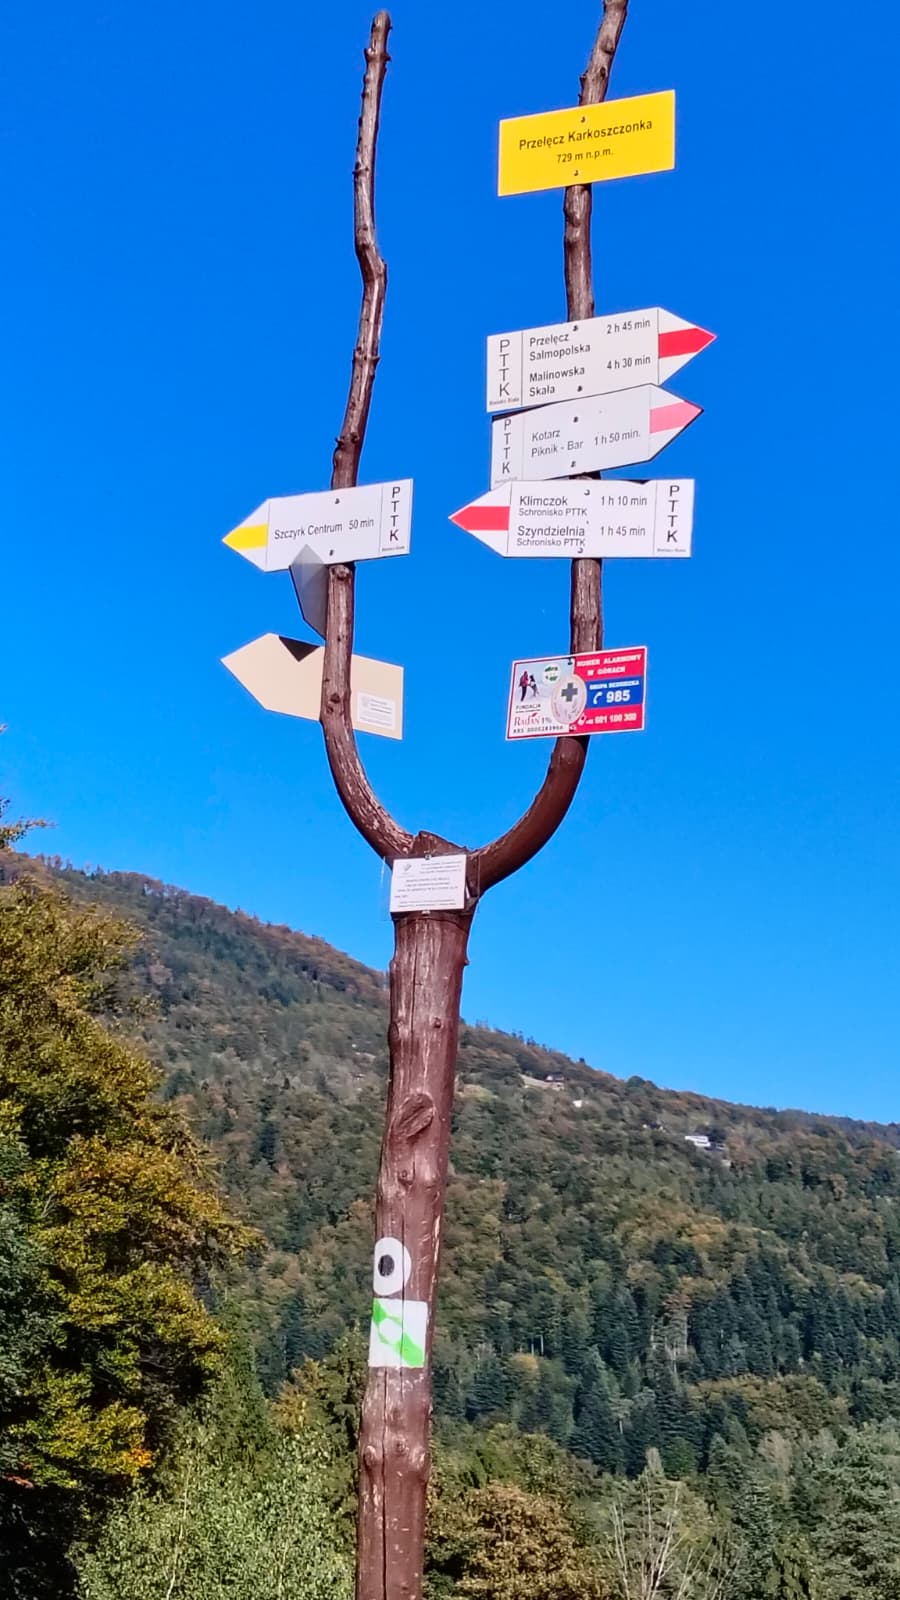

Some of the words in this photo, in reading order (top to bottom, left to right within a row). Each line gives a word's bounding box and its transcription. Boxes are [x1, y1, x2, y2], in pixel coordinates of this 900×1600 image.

[519, 134, 565, 150] Przełęcz
[568, 120, 652, 143] Karkoszczonka
[556, 152, 572, 164] 729
[575, 153, 584, 161] m
[586, 147, 614, 160] n.p.m.
[606, 324, 612, 334] 2
[614, 322, 620, 333] h
[621, 320, 633, 332] 45
[634, 318, 651, 330] min
[529, 343, 591, 362] Salmopolska
[606, 360, 612, 370] 4
[614, 359, 620, 369] h
[621, 358, 633, 368] 30
[634, 355, 651, 366] min
[529, 366, 585, 382] Malinowska
[532, 429, 561, 442] Kotarz
[594, 436, 598, 447] 1
[600, 436, 607, 446] h
[608, 432, 620, 444] 50
[622, 430, 641, 442] min.
[531, 443, 558, 458] Piknik
[567, 440, 584, 451] Bar
[519, 495, 568, 506] Klimczok
[600, 496, 605, 506] 1
[607, 495, 614, 506] h
[617, 495, 628, 506] 10
[630, 495, 648, 506] min
[518, 508, 563, 516] Schronisko
[566, 508, 588, 516] PTTK
[274, 526, 306, 540] Szczyrk
[307, 522, 343, 536] Centrum
[348, 519, 360, 531] 50
[360, 517, 374, 529] min
[518, 525, 585, 540] Szyndzielnia
[600, 526, 604, 536] 1
[606, 526, 612, 536] h
[615, 526, 627, 536] 45
[628, 526, 646, 536] min
[516, 538, 561, 546] Schronisko
[564, 537, 586, 546] PTTK
[606, 690, 631, 703] 985
